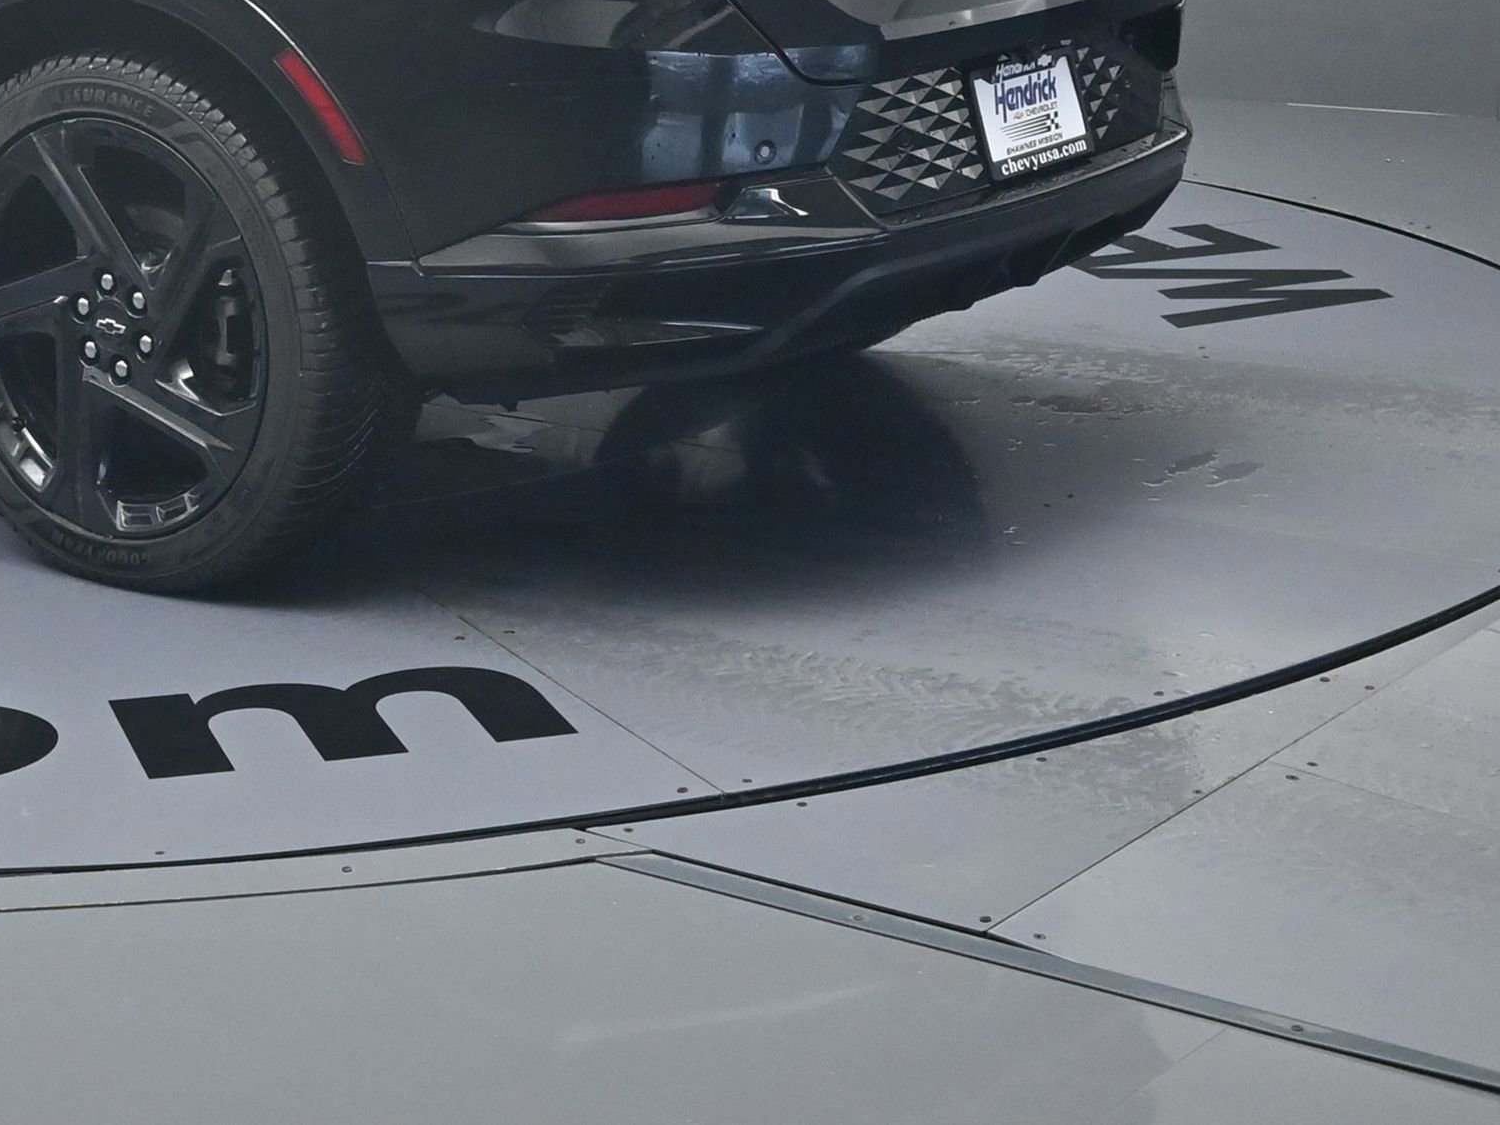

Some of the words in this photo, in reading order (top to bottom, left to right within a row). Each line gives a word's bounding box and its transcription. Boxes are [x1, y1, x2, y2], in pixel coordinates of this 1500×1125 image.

[994, 70, 1057, 123] Hendrick
[1026, 102, 1058, 117] CHEVROLET
[1001, 139, 1088, 176] chevyusa.com
[1006, 138, 1037, 155] SHAWNEE
[1038, 132, 1063, 146] MISSION
